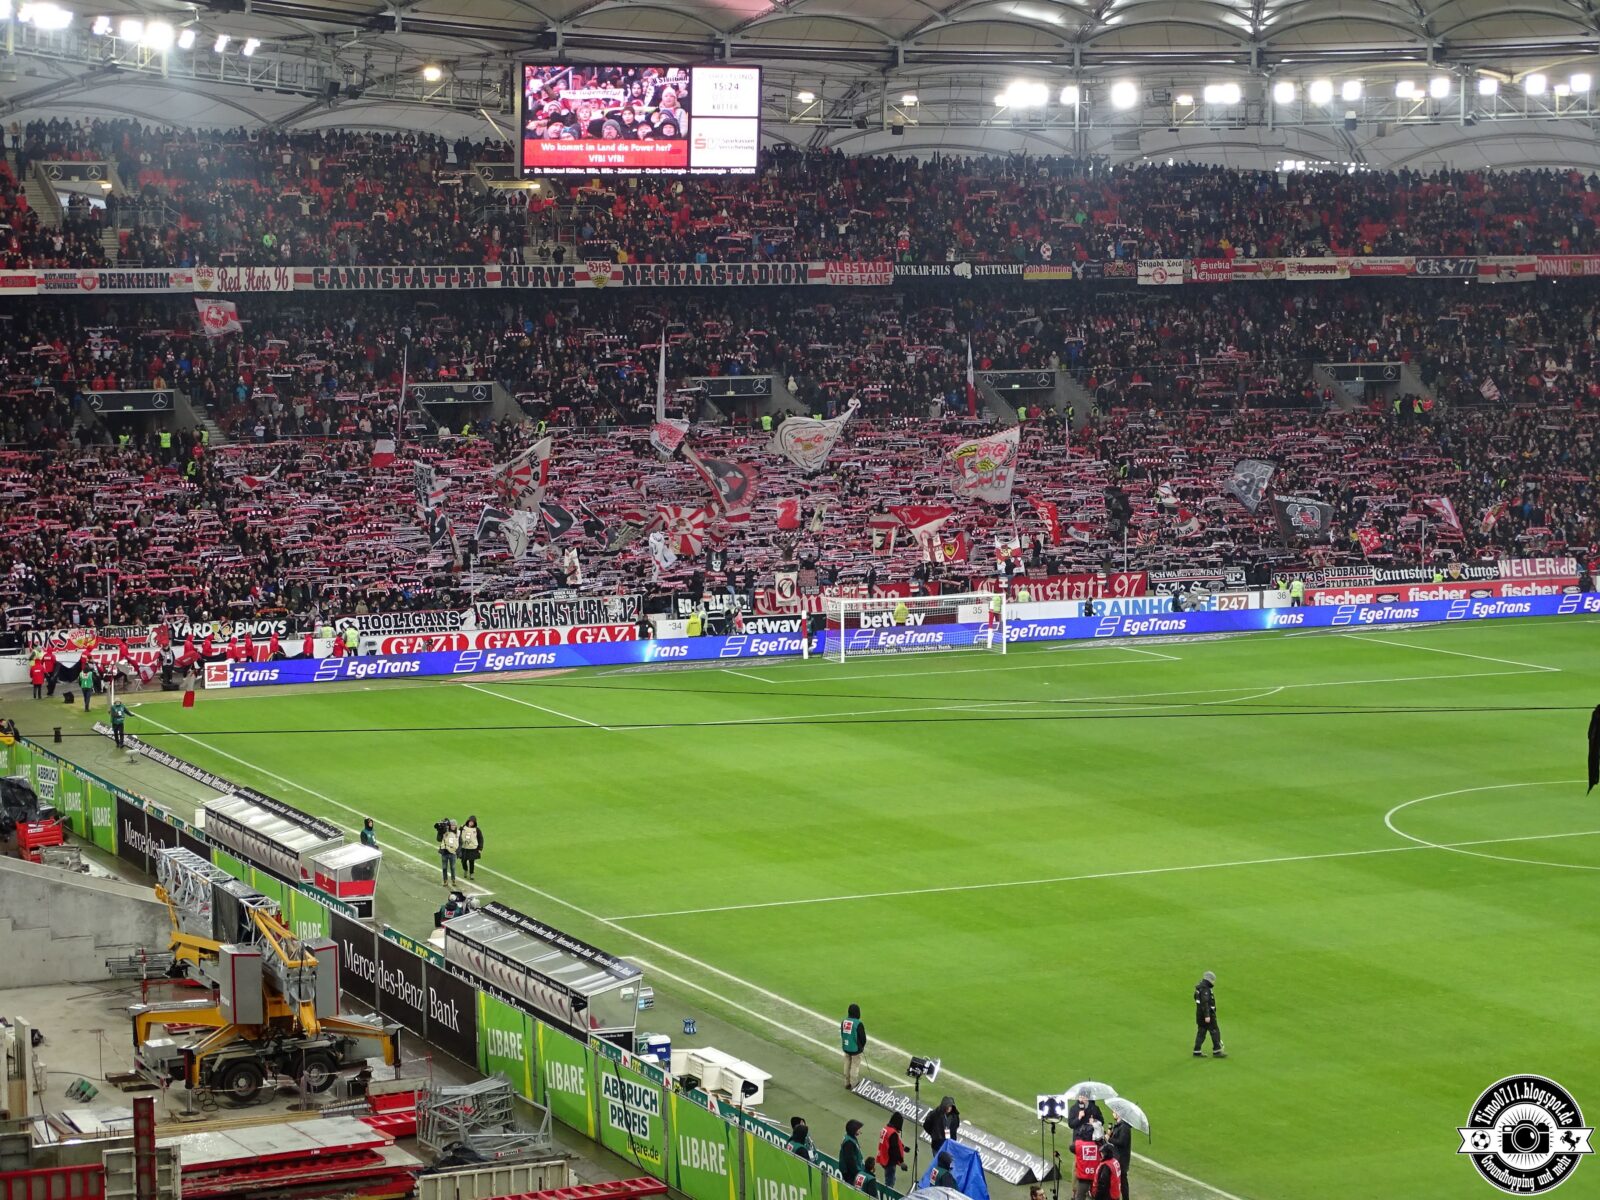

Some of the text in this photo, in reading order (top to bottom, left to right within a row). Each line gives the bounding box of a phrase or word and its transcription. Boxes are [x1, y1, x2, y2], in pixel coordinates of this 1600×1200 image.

[541, 143, 555, 151] Wo
[557, 143, 583, 151] kommt
[586, 143, 595, 151] im
[597, 143, 615, 151] Land
[617, 143, 628, 151] die
[630, 143, 654, 151] Power
[588, 154, 625, 163] VfB! VfB!
[622, 263, 809, 286] NECKARSTADION
[828, 260, 893, 274] ALBSTADT
[893, 263, 1023, 276] NECKAR-FILS STUTTGART
[1538, 259, 1571, 275] DONAU
[99, 272, 171, 289] BERKHEIM
[217, 265, 290, 292] Red Hots 96
[312, 265, 576, 290] CANNSTATTER KURVE
[829, 273, 891, 285] VFB-FANS
[1113, 573, 1143, 598] 97
[1325, 578, 1374, 589] STUTTGART
[1501, 582, 1559, 598] fischer
[1276, 592, 1287, 600] 36
[1313, 591, 1373, 606] fischer
[1408, 586, 1467, 602] fischer
[973, 606, 983, 615] 35
[1219, 596, 1247, 611] 247
[1472, 601, 1531, 618] EgeTrans
[357, 610, 460, 631] HOOLIGANS
[1358, 607, 1420, 623] EgeTrans
[172, 620, 287, 638] YARD BWOYS
[1004, 624, 1067, 642] EgeTrans
[1122, 618, 1186, 636] EgeTrans
[878, 631, 944, 647] EgeTrans
[16, 658, 27, 666] 32
[346, 659, 421, 679] EgeTrans
[484, 651, 557, 670] EgeTrans
[343, 938, 460, 1034] Mercedes-Benz Bank
[487, 1027, 524, 1062] LIBARE
[545, 1060, 587, 1097] LIBARE
[603, 1075, 659, 1114] ABBRUCH
[852, 1077, 923, 1122] Mercedes-Benz
[610, 1103, 649, 1137] PROFIS
[679, 1133, 728, 1177] LIBARE
[995, 1158, 1025, 1183] Bank
